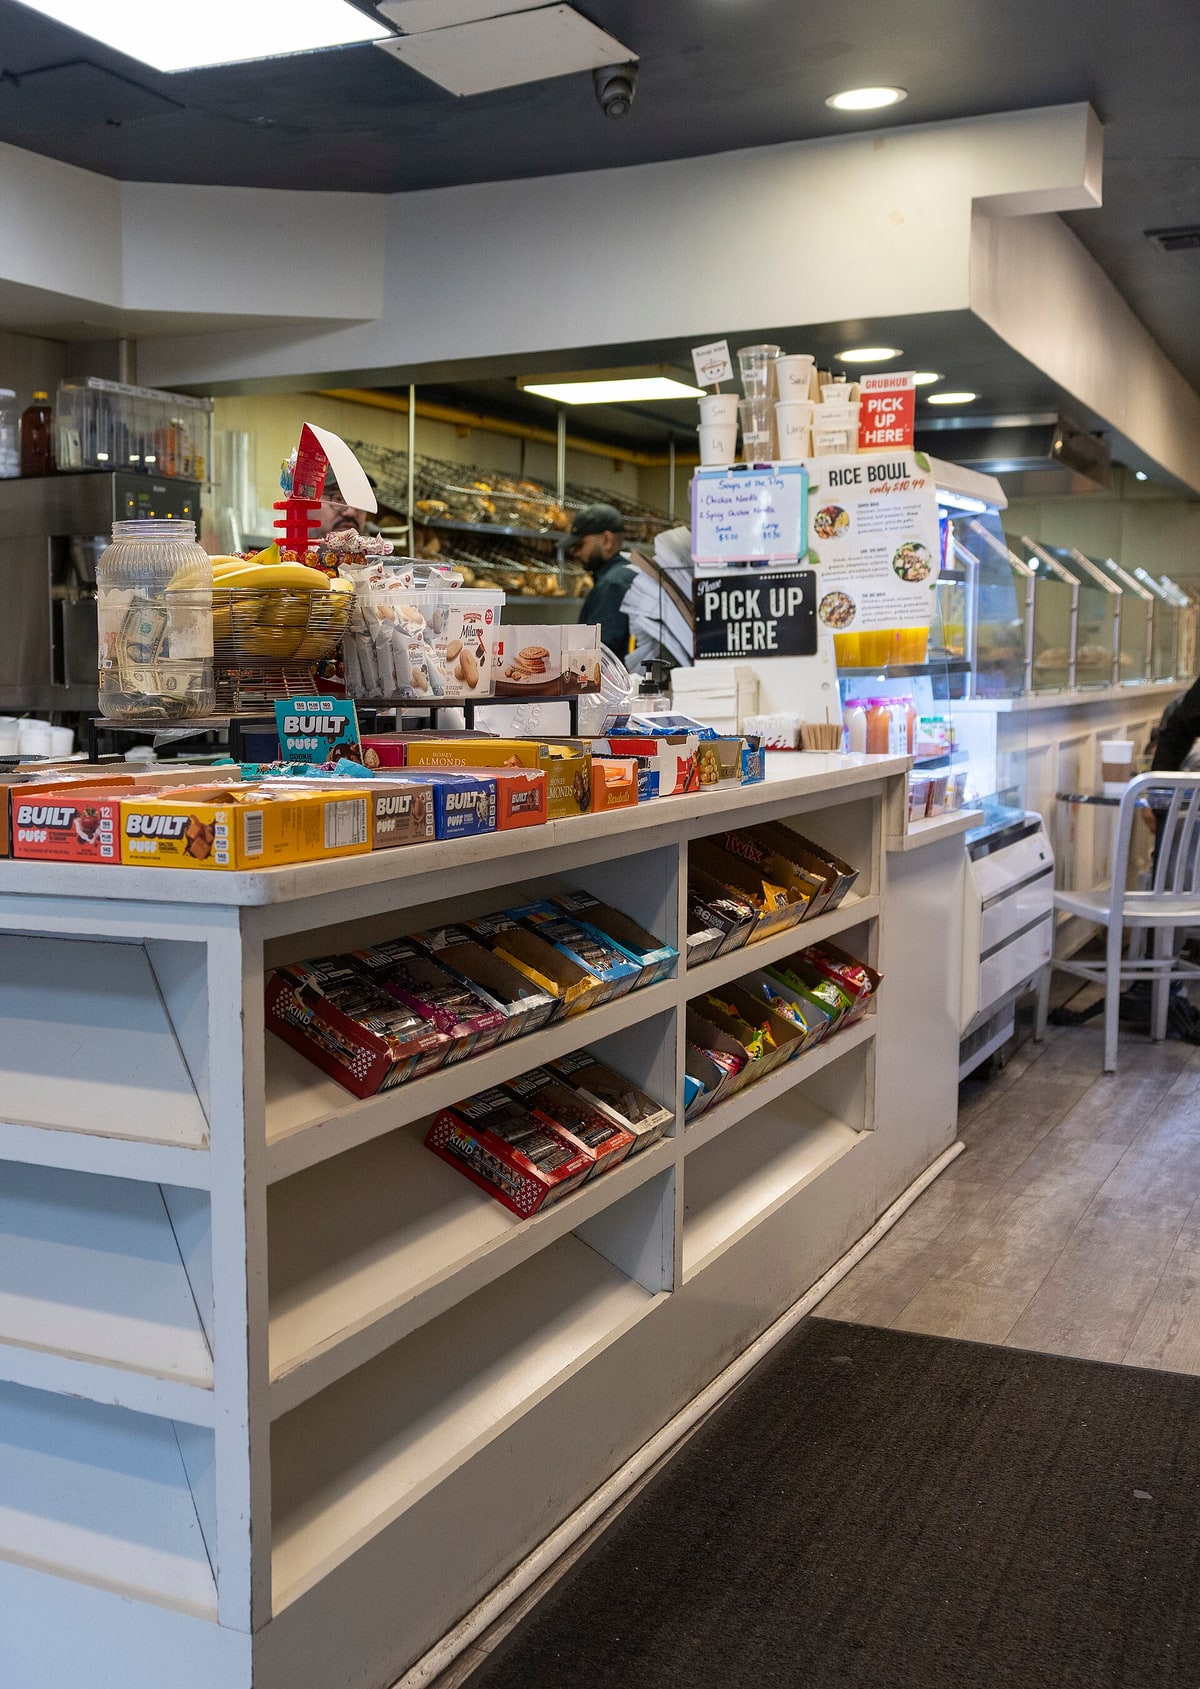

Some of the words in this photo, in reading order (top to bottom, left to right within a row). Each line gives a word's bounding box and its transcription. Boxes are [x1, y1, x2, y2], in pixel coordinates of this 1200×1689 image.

[865, 377, 908, 389] GRUBHUB
[868, 397, 904, 413] PICK
[874, 414, 896, 428] UP
[865, 428, 904, 444] HERE
[768, 476, 784, 489] Day
[829, 467, 862, 487] RICE
[868, 462, 911, 482] BOWL
[869, 484, 892, 496] only
[705, 589, 761, 621] PICK
[770, 586, 804, 618] UP
[459, 624, 484, 640] Milano
[727, 620, 778, 651] HERE
[284, 716, 346, 733] BUILT
[286, 738, 318, 750] PUFF
[418, 758, 466, 766] ALMONDS
[446, 792, 478, 811] BUILT
[512, 792, 527, 803] BUILT
[606, 790, 630, 804] Barebells
[376, 795, 413, 816] BUILT
[17, 806, 76, 826] BUILT
[100, 806, 110, 818] 12
[126, 814, 188, 836] BUILT
[215, 812, 226, 822] 12
[448, 815, 463, 827] PUFF
[376, 820, 396, 833] PUFF
[18, 830, 47, 842] PUFF
[129, 840, 157, 853] PUFF
[726, 832, 762, 864] Twix
[694, 905, 710, 921] 36
[364, 954, 394, 968] KIND
[288, 1002, 310, 1026] KIND
[446, 1046, 470, 1064] KIND
[560, 1061, 581, 1076] KIND
[384, 1068, 411, 1088] KIND
[512, 1081, 537, 1096] KIND
[462, 1102, 490, 1120] KIND
[450, 1132, 473, 1155] KIND
